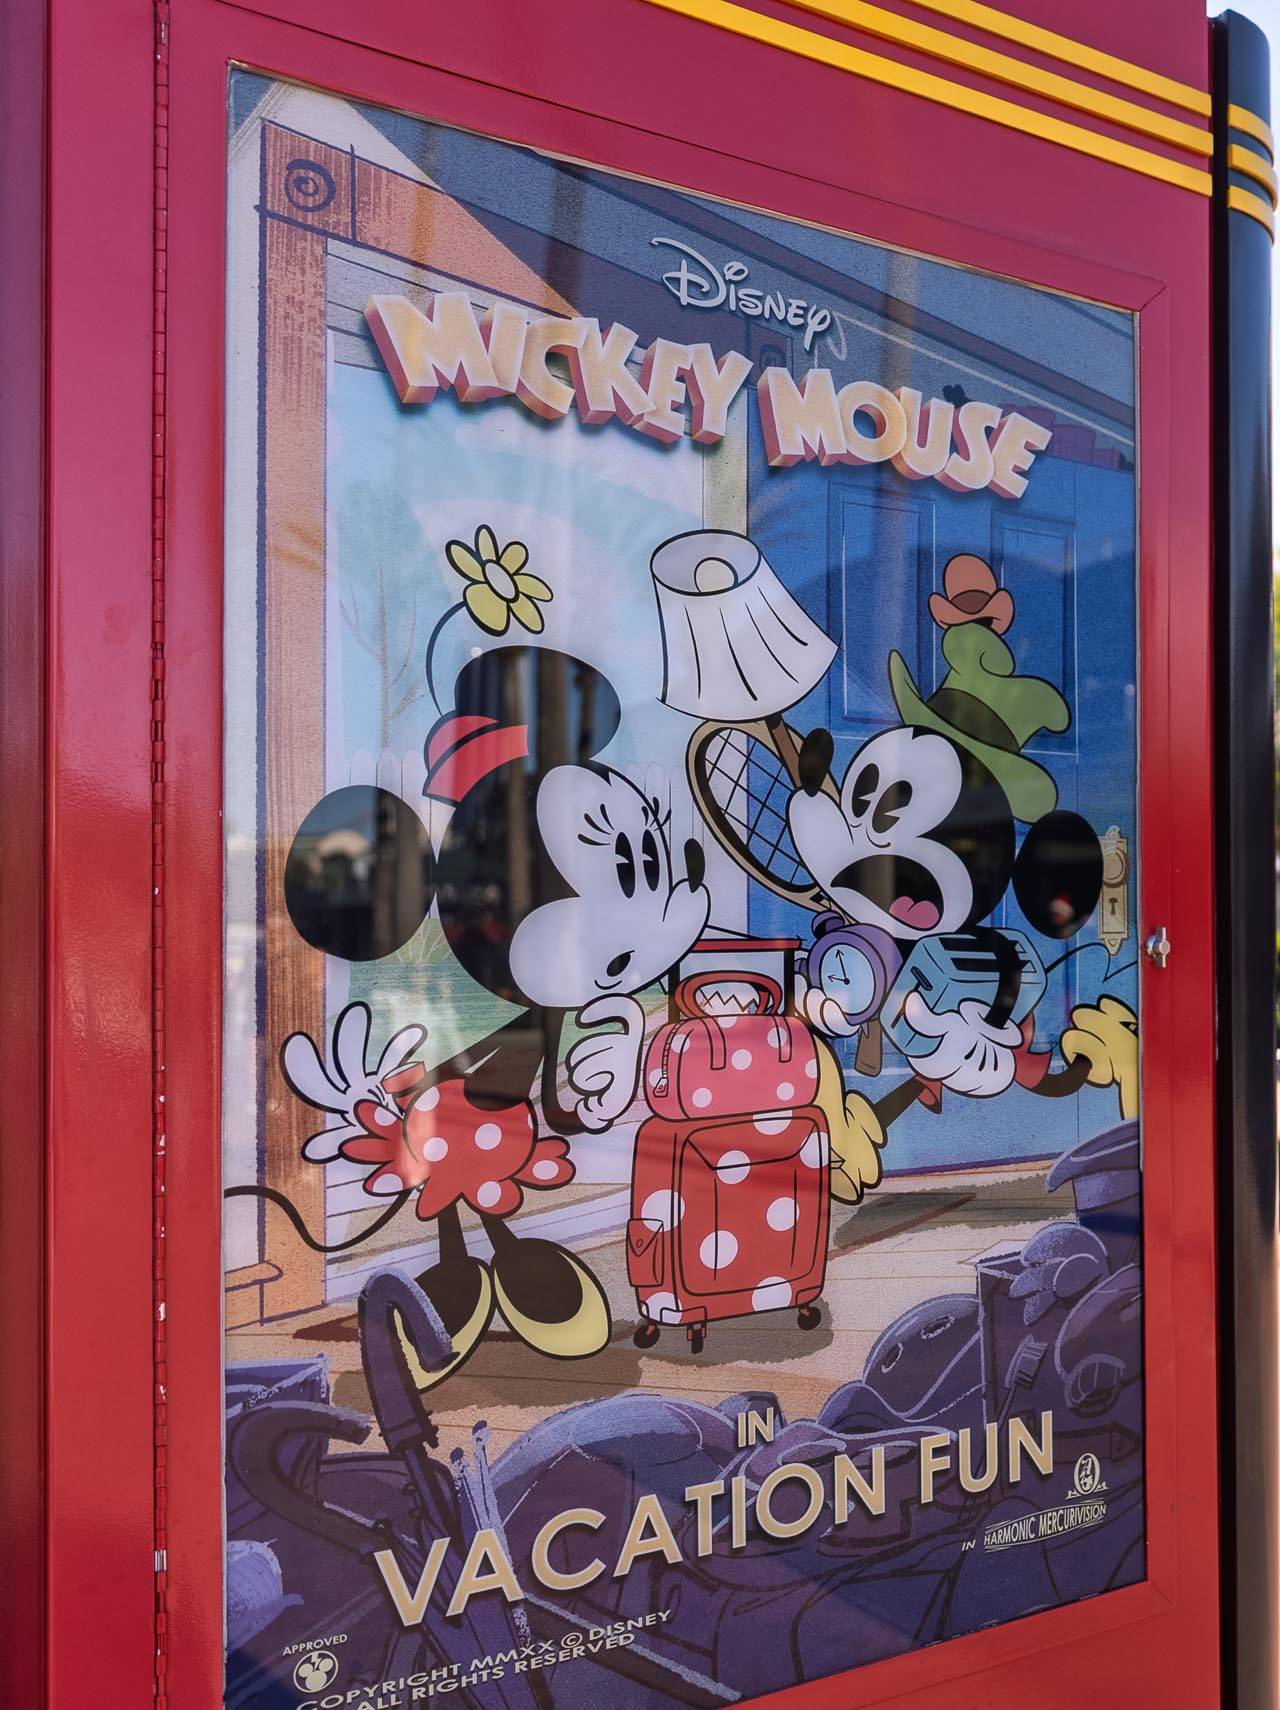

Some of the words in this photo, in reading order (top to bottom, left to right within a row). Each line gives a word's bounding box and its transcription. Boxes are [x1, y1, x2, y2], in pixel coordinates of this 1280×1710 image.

[362, 290, 753, 444] MICKEY
[758, 365, 1053, 499] MOUSE
[737, 1406, 775, 1448] IN
[373, 1445, 888, 1628] VACATION
[919, 1410, 1055, 1503] FUN
[961, 1539, 977, 1551] IN
[984, 1516, 1036, 1546] HARMONIC
[1038, 1503, 1107, 1537] MERCURIVISION
[282, 1633, 348, 1656] APPROVED
[296, 1663, 462, 1710] COPYRIGHT
[470, 1640, 554, 1672] MMXX
[589, 1609, 672, 1641] DISNEY
[356, 1694, 402, 1710] ALL
[412, 1666, 504, 1701] RIGHTS
[514, 1633, 636, 1674] RESERVED
